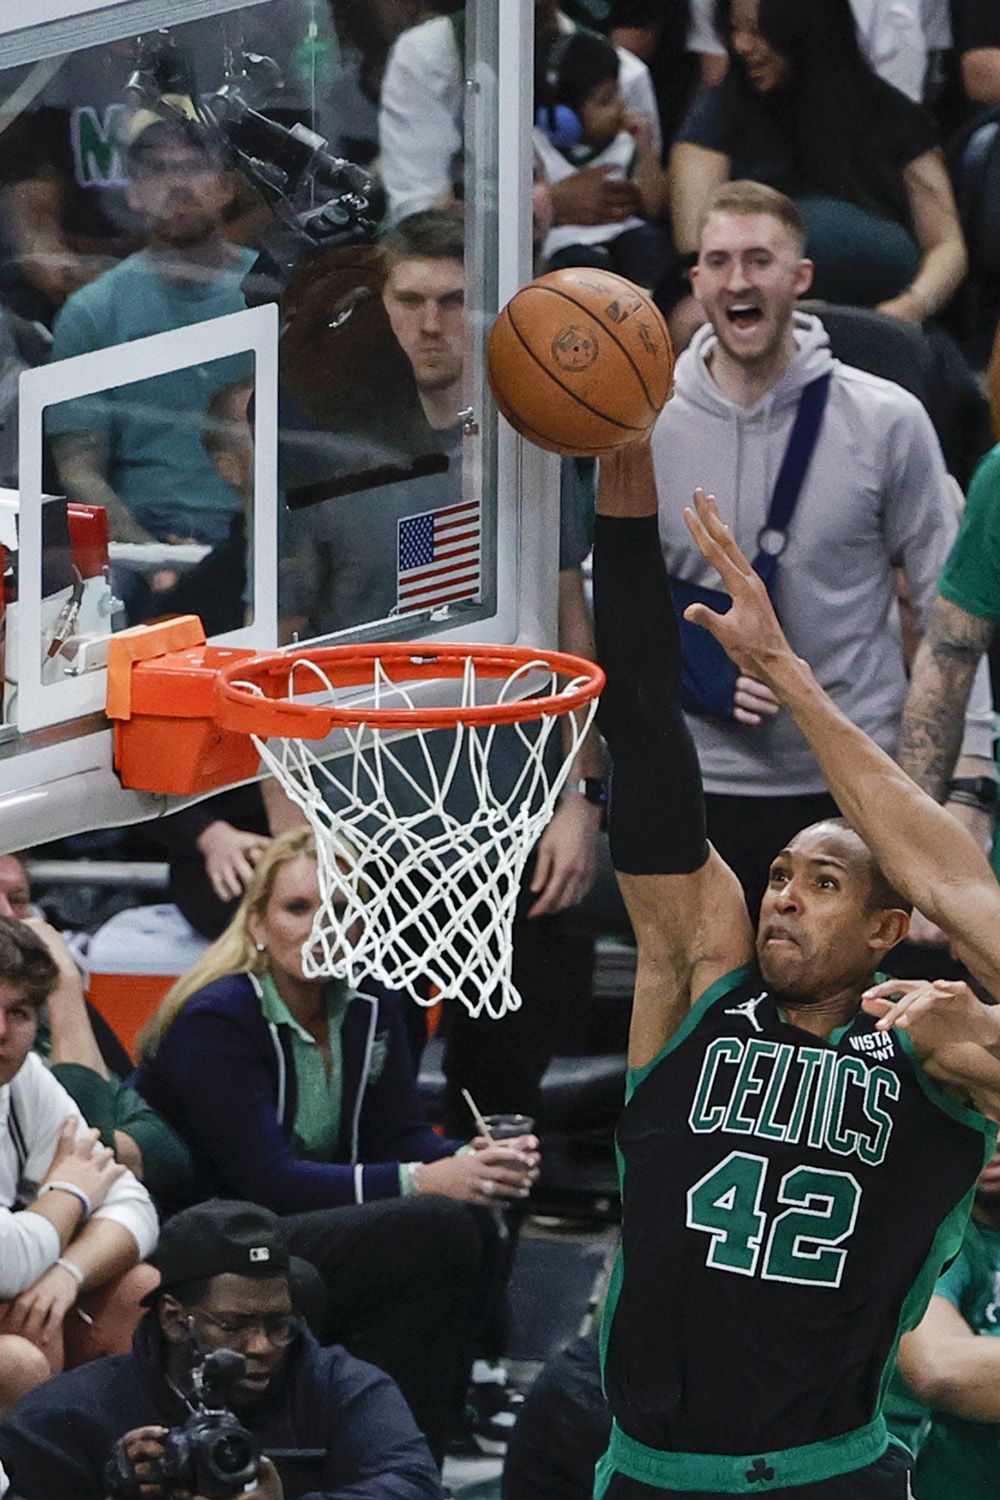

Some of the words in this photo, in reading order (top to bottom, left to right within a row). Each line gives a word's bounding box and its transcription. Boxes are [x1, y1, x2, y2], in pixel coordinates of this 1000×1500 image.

[688, 1037, 901, 1166] CELTICS
[849, 1031, 892, 1051] VISTA
[686, 1150, 863, 1288] 42
